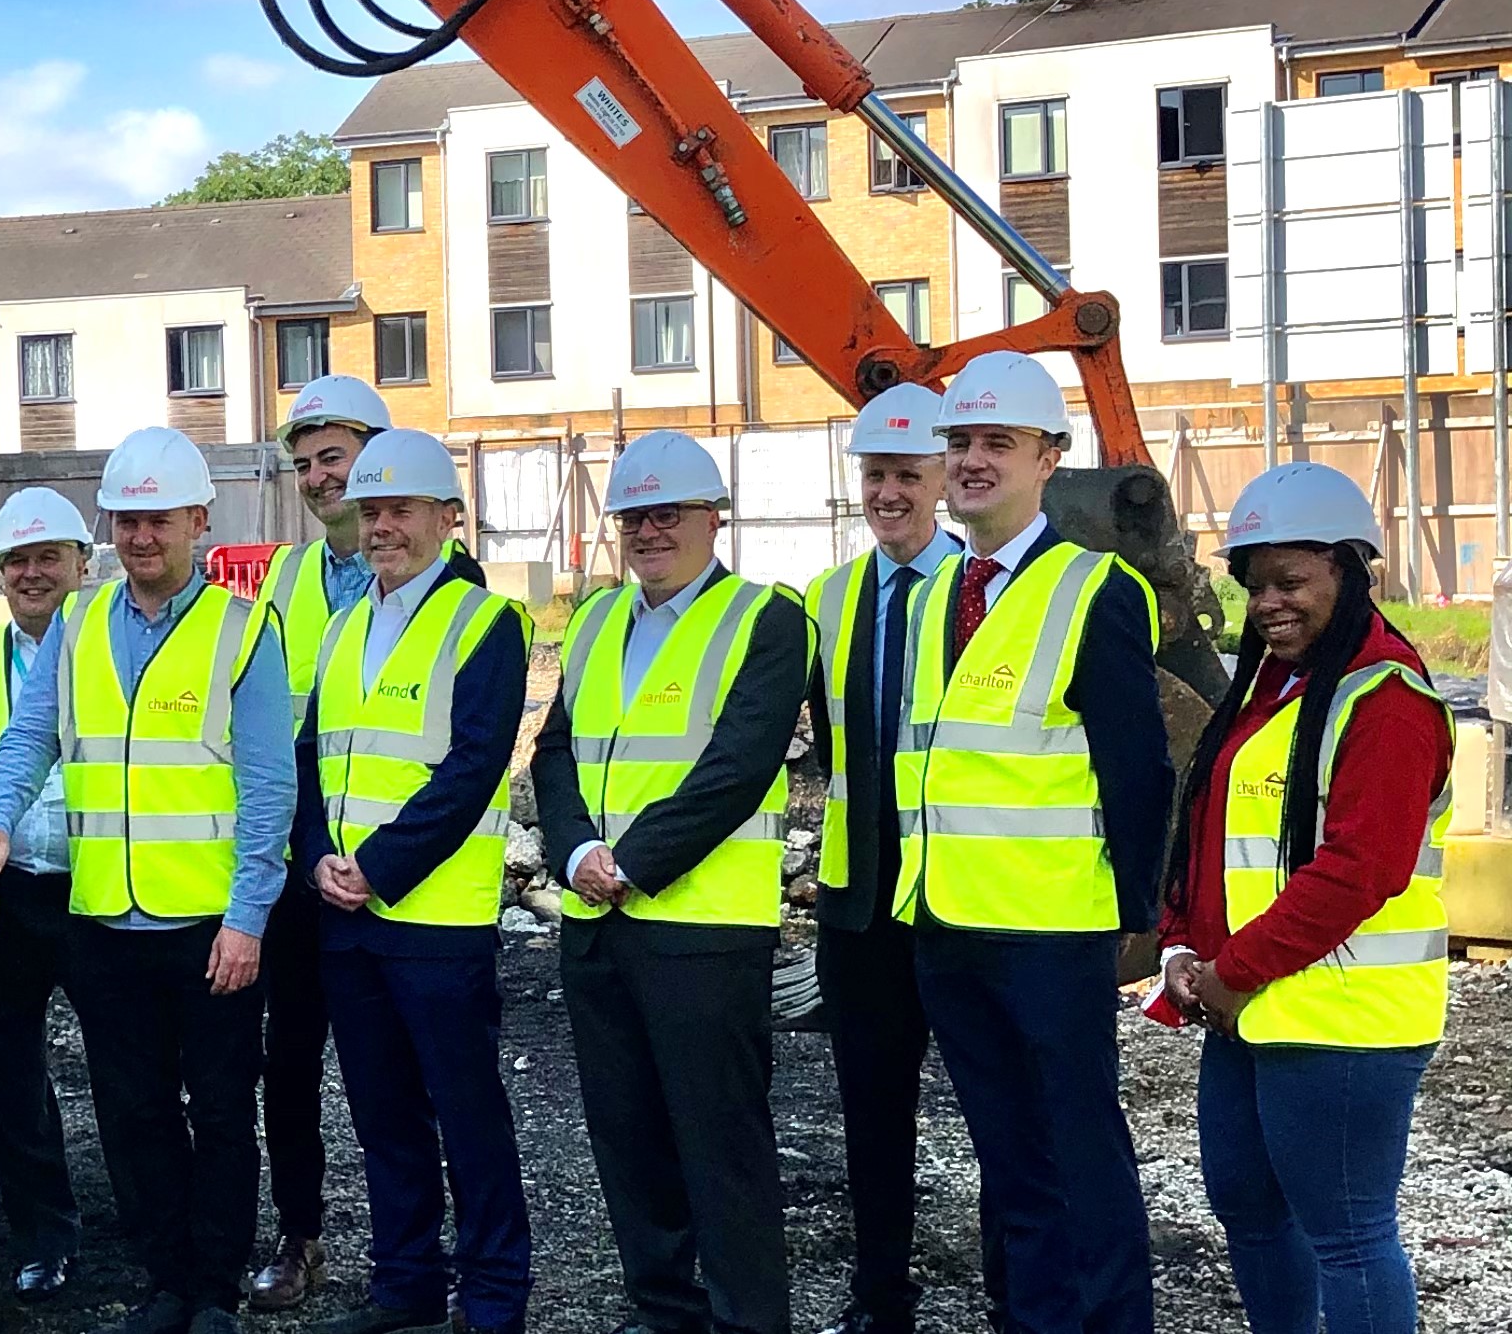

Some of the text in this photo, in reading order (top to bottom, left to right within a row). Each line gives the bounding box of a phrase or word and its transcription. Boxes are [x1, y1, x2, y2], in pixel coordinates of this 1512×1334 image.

[954, 399, 996, 411] charlton
[355, 467, 383, 484] kind
[121, 485, 158, 495] charlton
[623, 482, 661, 496] charlton
[377, 678, 411, 699] kind
[959, 671, 1014, 690] charlton
[147, 697, 199, 713] charlton
